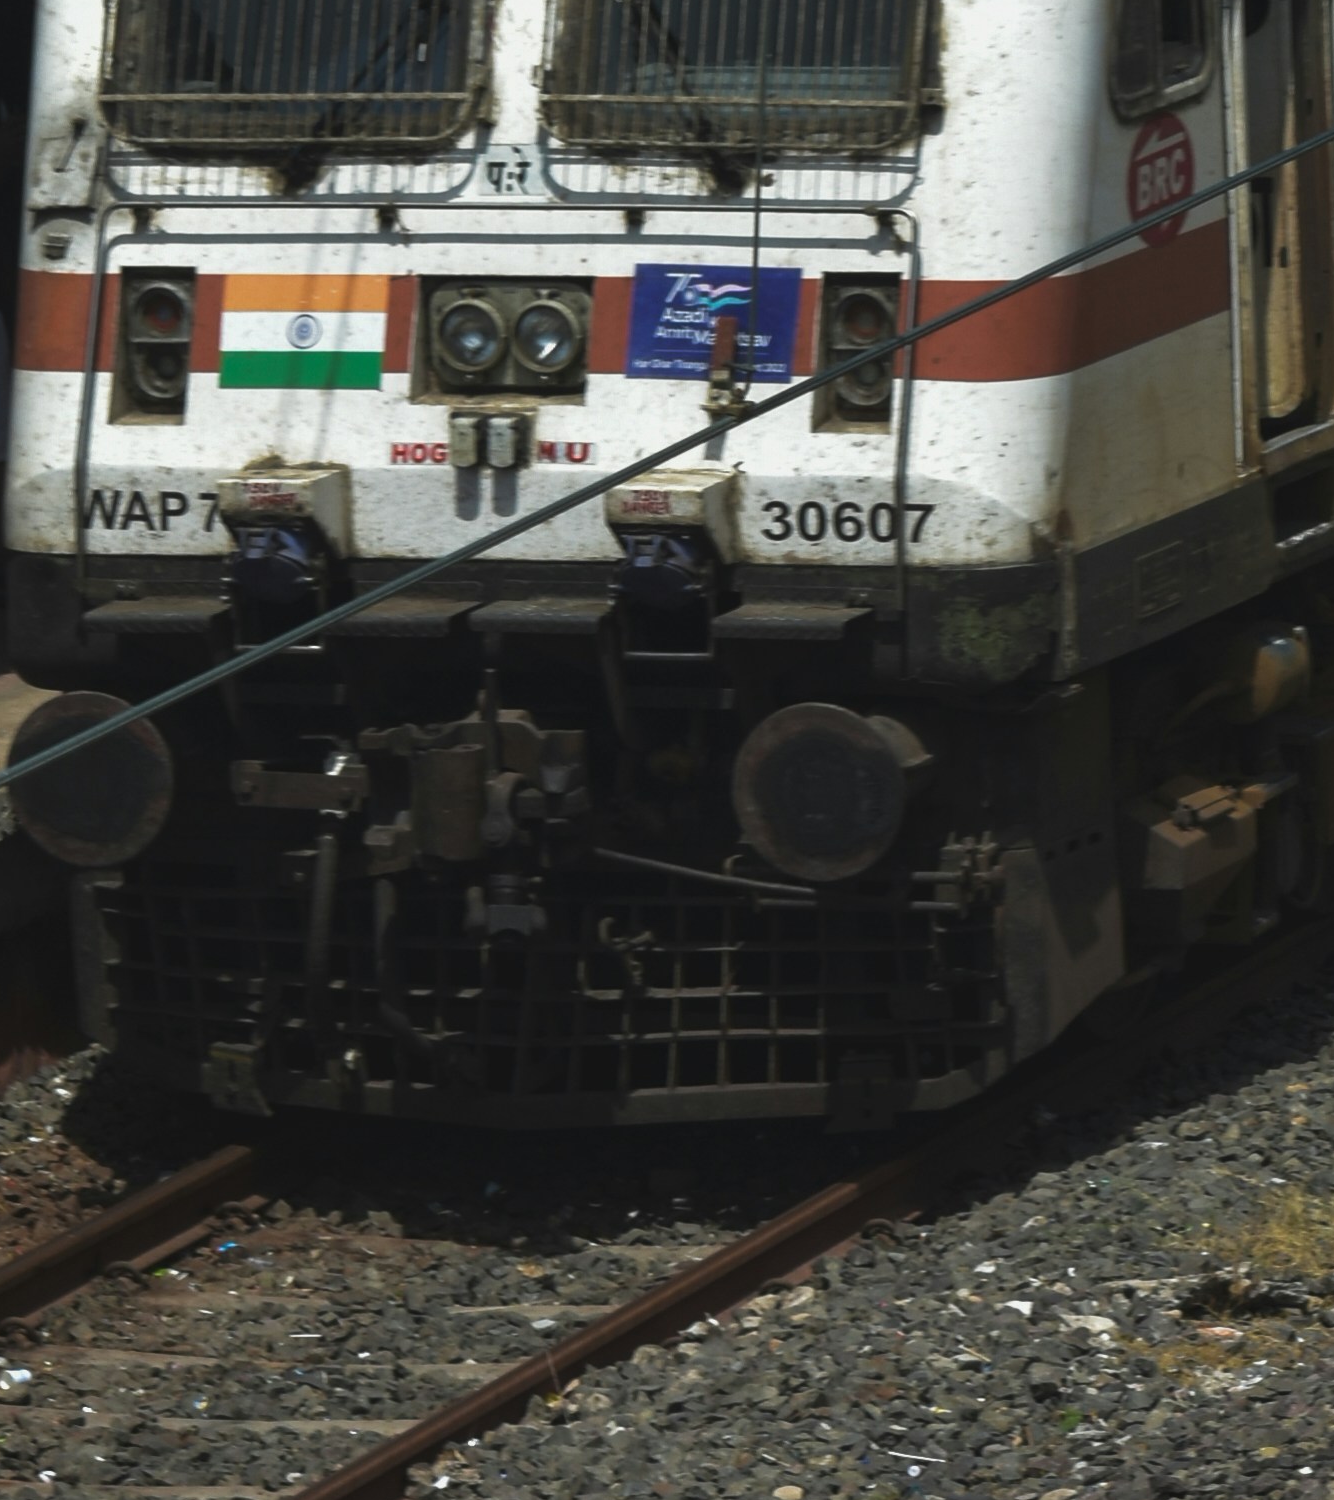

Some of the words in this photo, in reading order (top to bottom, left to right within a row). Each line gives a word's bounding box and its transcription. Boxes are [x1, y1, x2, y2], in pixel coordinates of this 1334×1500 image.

[1135, 147, 1185, 213] BRC
[391, 442, 449, 464] HOG
[83, 489, 190, 531] WAP
[198, 493, 221, 533] 7
[761, 500, 935, 543] 30607
